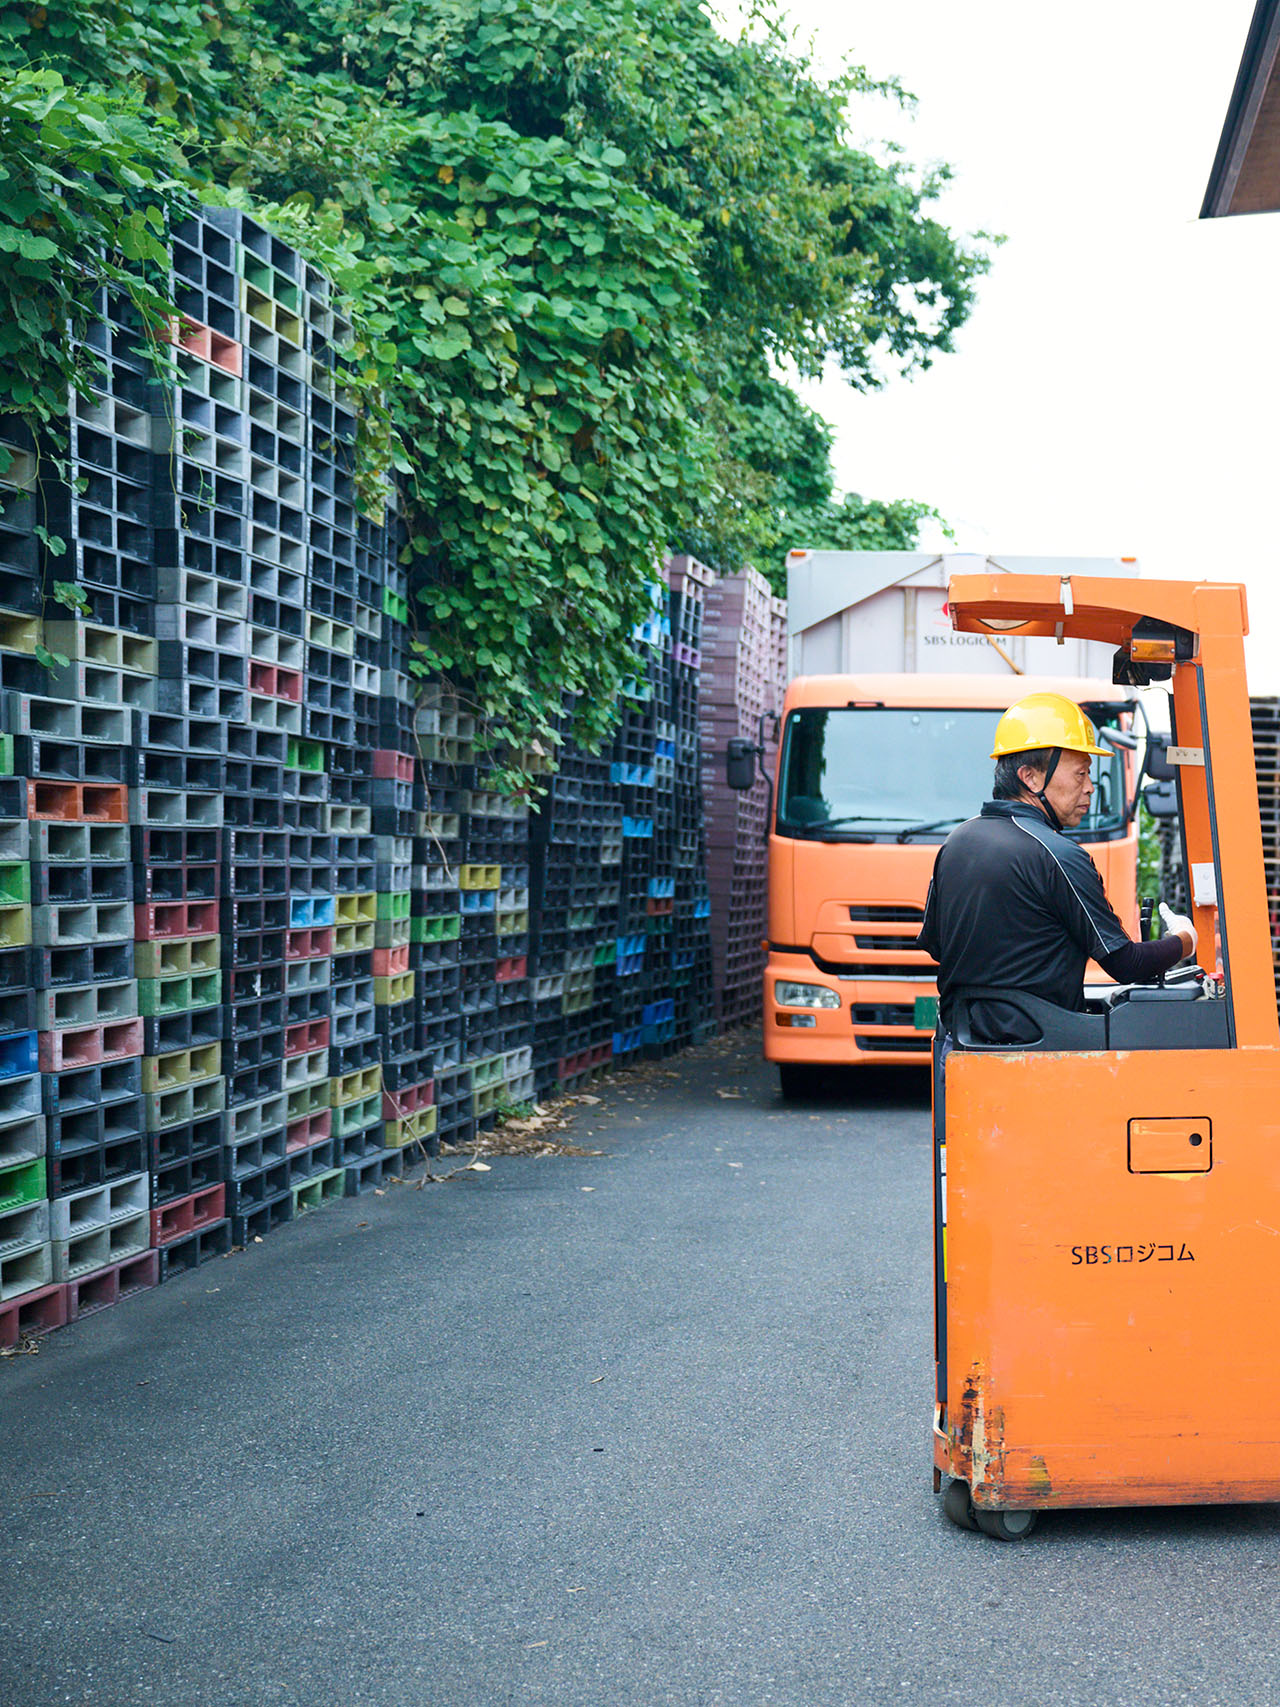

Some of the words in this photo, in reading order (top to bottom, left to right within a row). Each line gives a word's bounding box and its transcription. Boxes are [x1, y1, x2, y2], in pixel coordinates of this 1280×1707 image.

[924, 635, 947, 646] SBS
[1071, 1242, 1196, 1266] SBSロジコム
